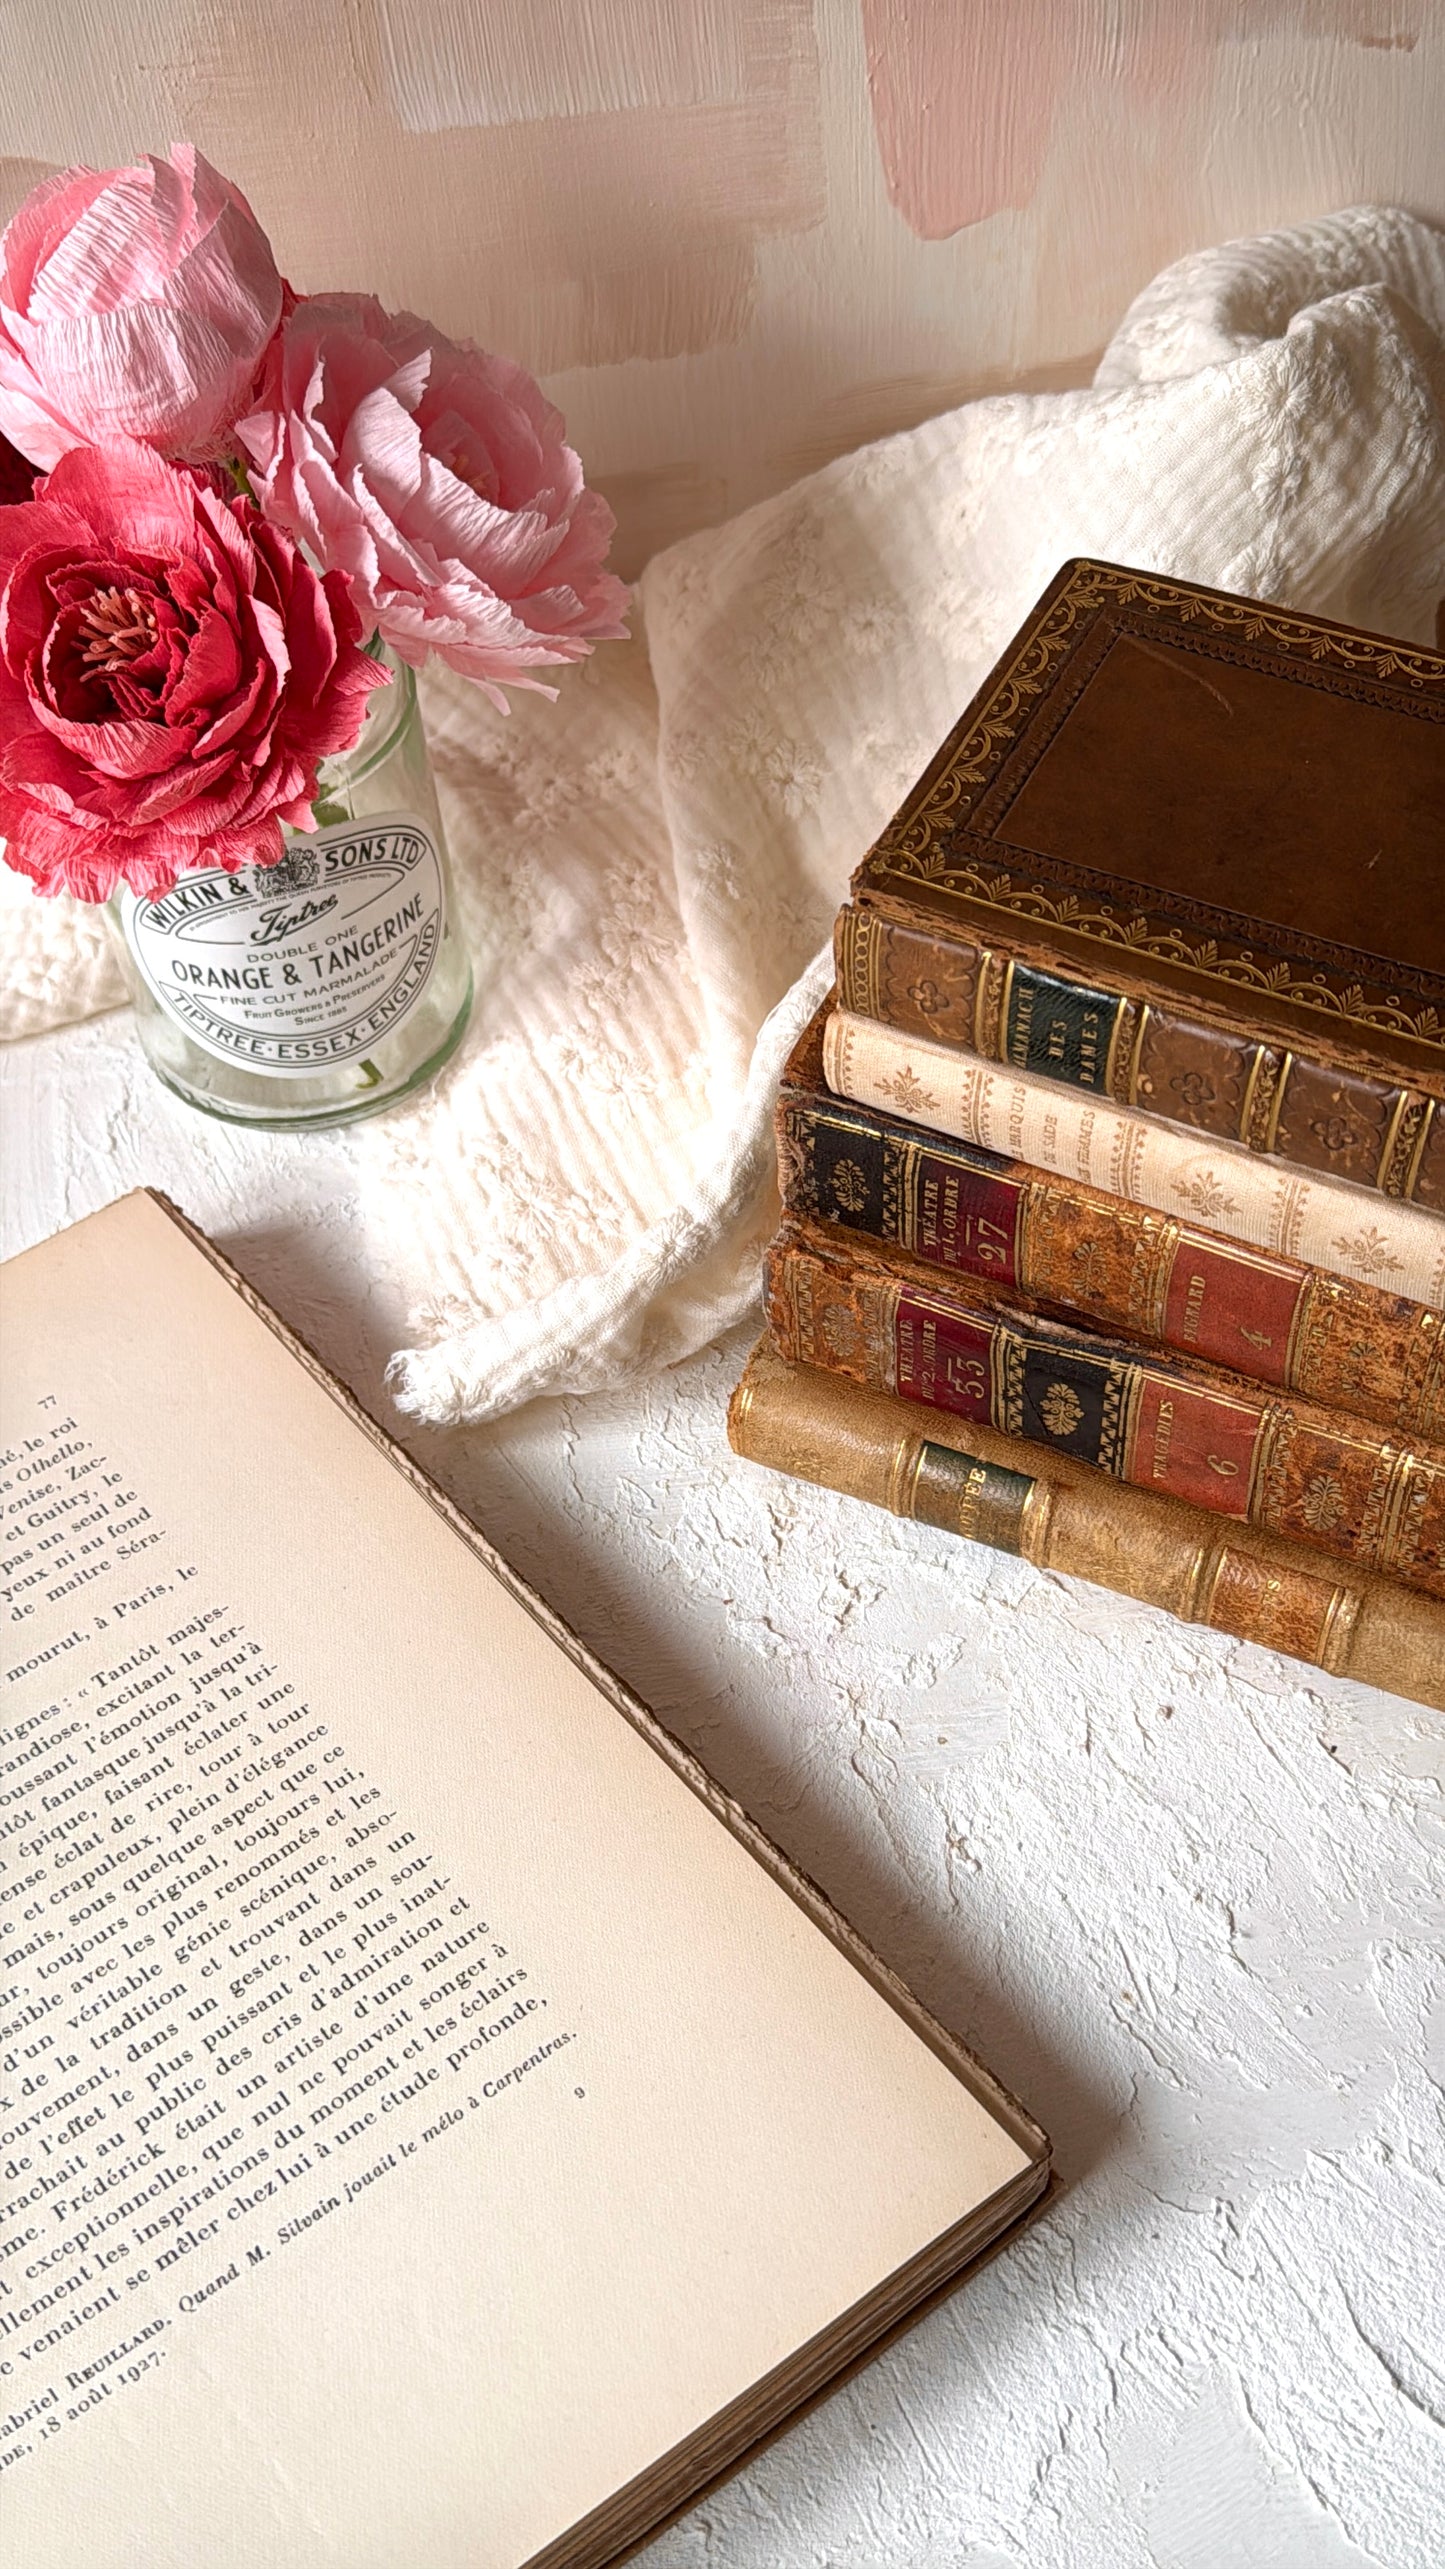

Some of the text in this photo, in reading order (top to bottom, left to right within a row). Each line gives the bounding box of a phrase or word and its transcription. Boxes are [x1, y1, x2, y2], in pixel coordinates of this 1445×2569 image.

[146, 883, 224, 929] WILKIN
[228, 877, 251, 895] &
[325, 837, 387, 871] SONS
[391, 836, 419, 864] LTD
[251, 894, 339, 944] Tiptree
[172, 893, 424, 990] ORANGE & TANGERINE
[220, 948, 398, 1006] FINE CUT MARMALADE
[247, 925, 358, 963] DOUBLE ONE
[174, 924, 435, 1059] TIPTREE ESSEX ENGLAND
[1012, 987, 1034, 1069] ALMANACH
[1048, 1020, 1068, 1059] DES
[1080, 1012, 1099, 1084] DAMES
[943, 1175, 960, 1230] ORDRE
[977, 1217, 1008, 1265] 27
[1239, 1326, 1273, 1351] 4
[37, 1394, 57, 1410] 77
[48, 1416, 78, 1440] roi
[16, 1441, 93, 1482] Othello,
[64, 1456, 107, 1482] Zac-
[1206, 1454, 1239, 1476] 6
[0, 1503, 110, 1576] pas seul
[0, 1506, 152, 1603] yeux fond
[27, 1489, 99, 1528] Guitry,
[45, 1530, 167, 1602] maître Séra-
[5, 1584, 174, 1683] mourut, Paris,
[89, 1644, 161, 1689] Tantôt
[166, 1605, 229, 1646] majes-
[95, 1664, 176, 1718] excitant
[209, 1625, 246, 1648] ter-
[18, 1683, 295, 1858] épique, faisant éclater une
[41, 1747, 141, 1813] fantasque
[244, 1663, 278, 1687] tri-
[54, 1703, 310, 1869] éclat rire, tour tour
[1, 1763, 318, 1970] mais, sous quelque aspect que
[36, 1767, 365, 1980] toujours original, toujours lui,
[49, 1834, 162, 1905] crapuleux,
[167, 1793, 222, 1835] plein
[70, 1787, 381, 1994] avec les plus renommés les
[65, 1964, 163, 2029] véritable
[174, 1918, 232, 1965] génie
[239, 1855, 337, 1918] scénique,
[344, 1810, 398, 1849] abso-
[89, 1856, 378, 2051] tradition trouvant dans
[126, 1854, 433, 2063] dans geste, dans sou-
[144, 2049, 194, 2093] plus
[200, 1981, 293, 2055] puissant
[351, 1912, 398, 1952] plus
[399, 1877, 451, 1914] inat-
[25, 1957, 488, 2279] exceptionnelle, que nul pouvait songer
[49, 2142, 167, 2223] Frédérick
[175, 2099, 227, 2141] était
[273, 2022, 343, 2074] artiste
[420, 1921, 490, 1974] nature
[133, 2077, 207, 2137] public
[215, 2046, 253, 2076] des
[261, 2013, 302, 2045] cris
[573, 2086, 586, 2100] 9
[92, 1968, 528, 2272] les inspirations moment les éclairs
[17, 1998, 548, 2361] venaient mêler chez lui une étude profonde,
[178, 2262, 241, 2313] Quand
[245, 2244, 272, 2267] M.
[276, 2196, 341, 2246] Silvain
[343, 2153, 397, 2204] jouait
[421, 2108, 465, 2144] mélo
[482, 2032, 577, 2098] Carpentras.
[38, 2415, 62, 2441] 18
[116, 2351, 166, 2386] 1927.
